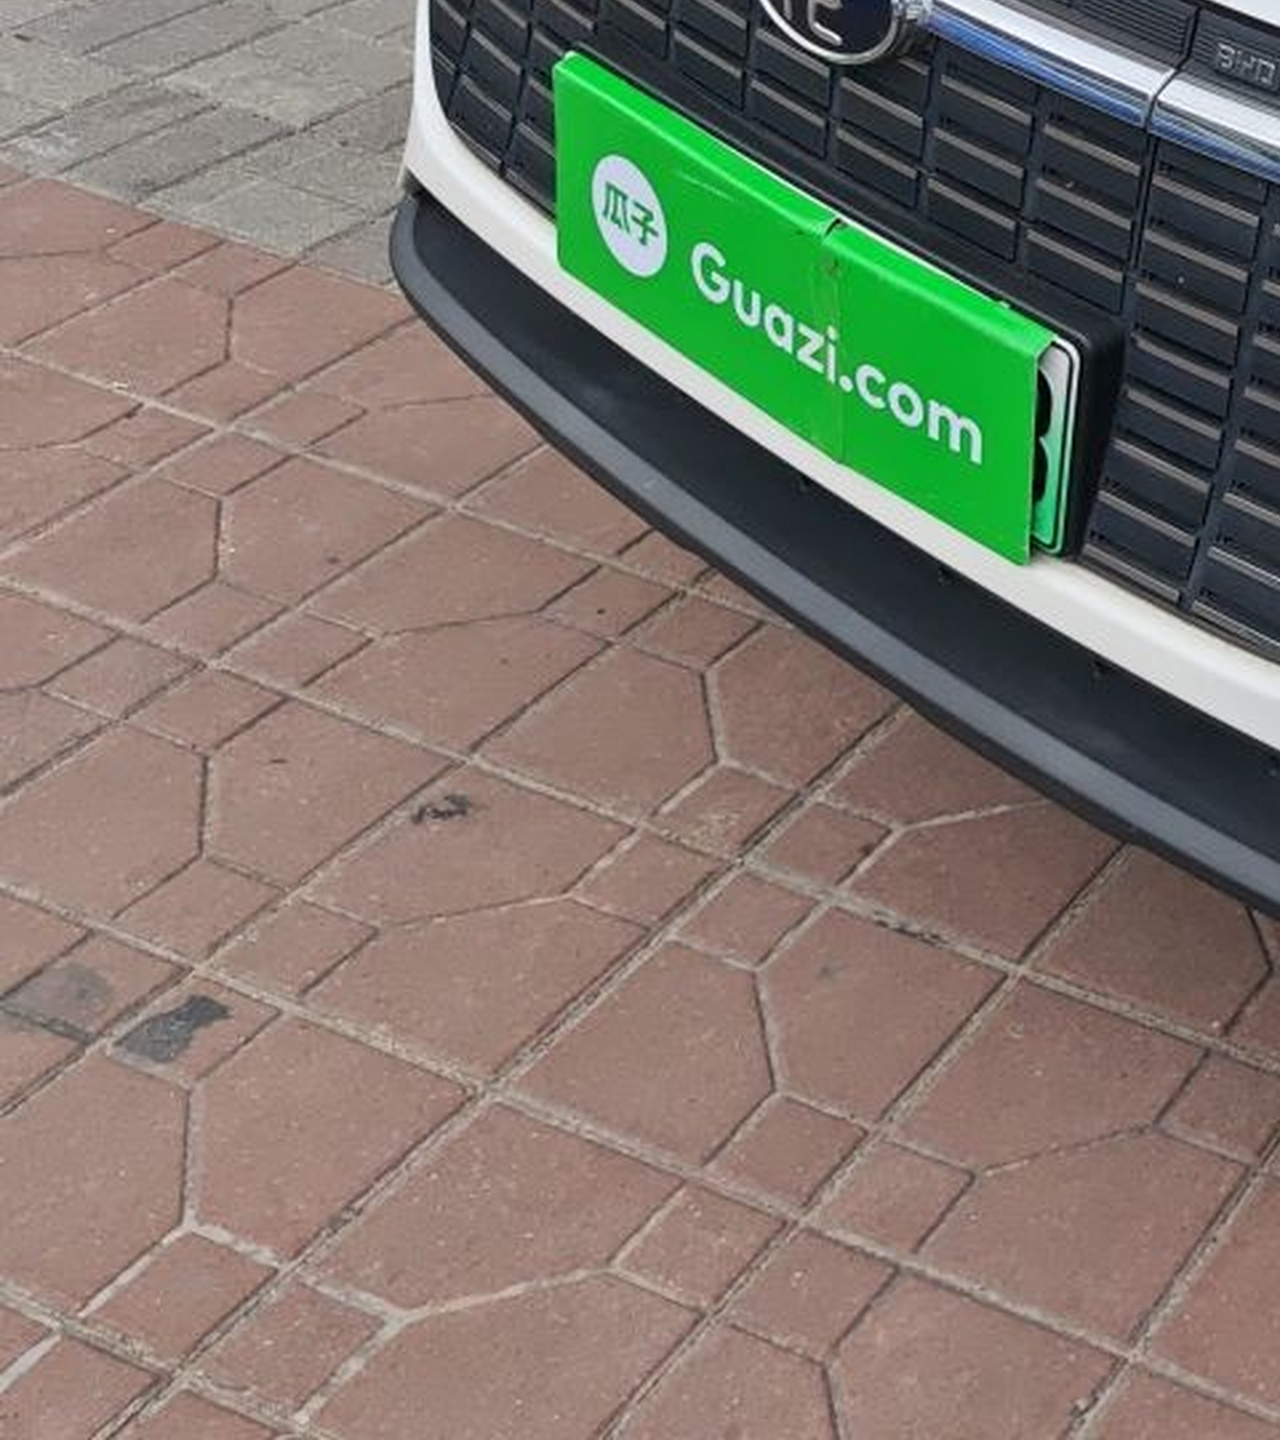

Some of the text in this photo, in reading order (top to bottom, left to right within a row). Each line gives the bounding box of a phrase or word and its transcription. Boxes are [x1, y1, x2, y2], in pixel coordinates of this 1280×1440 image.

[1218, 42, 1277, 87] BYD
[602, 180, 660, 247] 瓜子
[689, 241, 983, 466] Guazi.com
